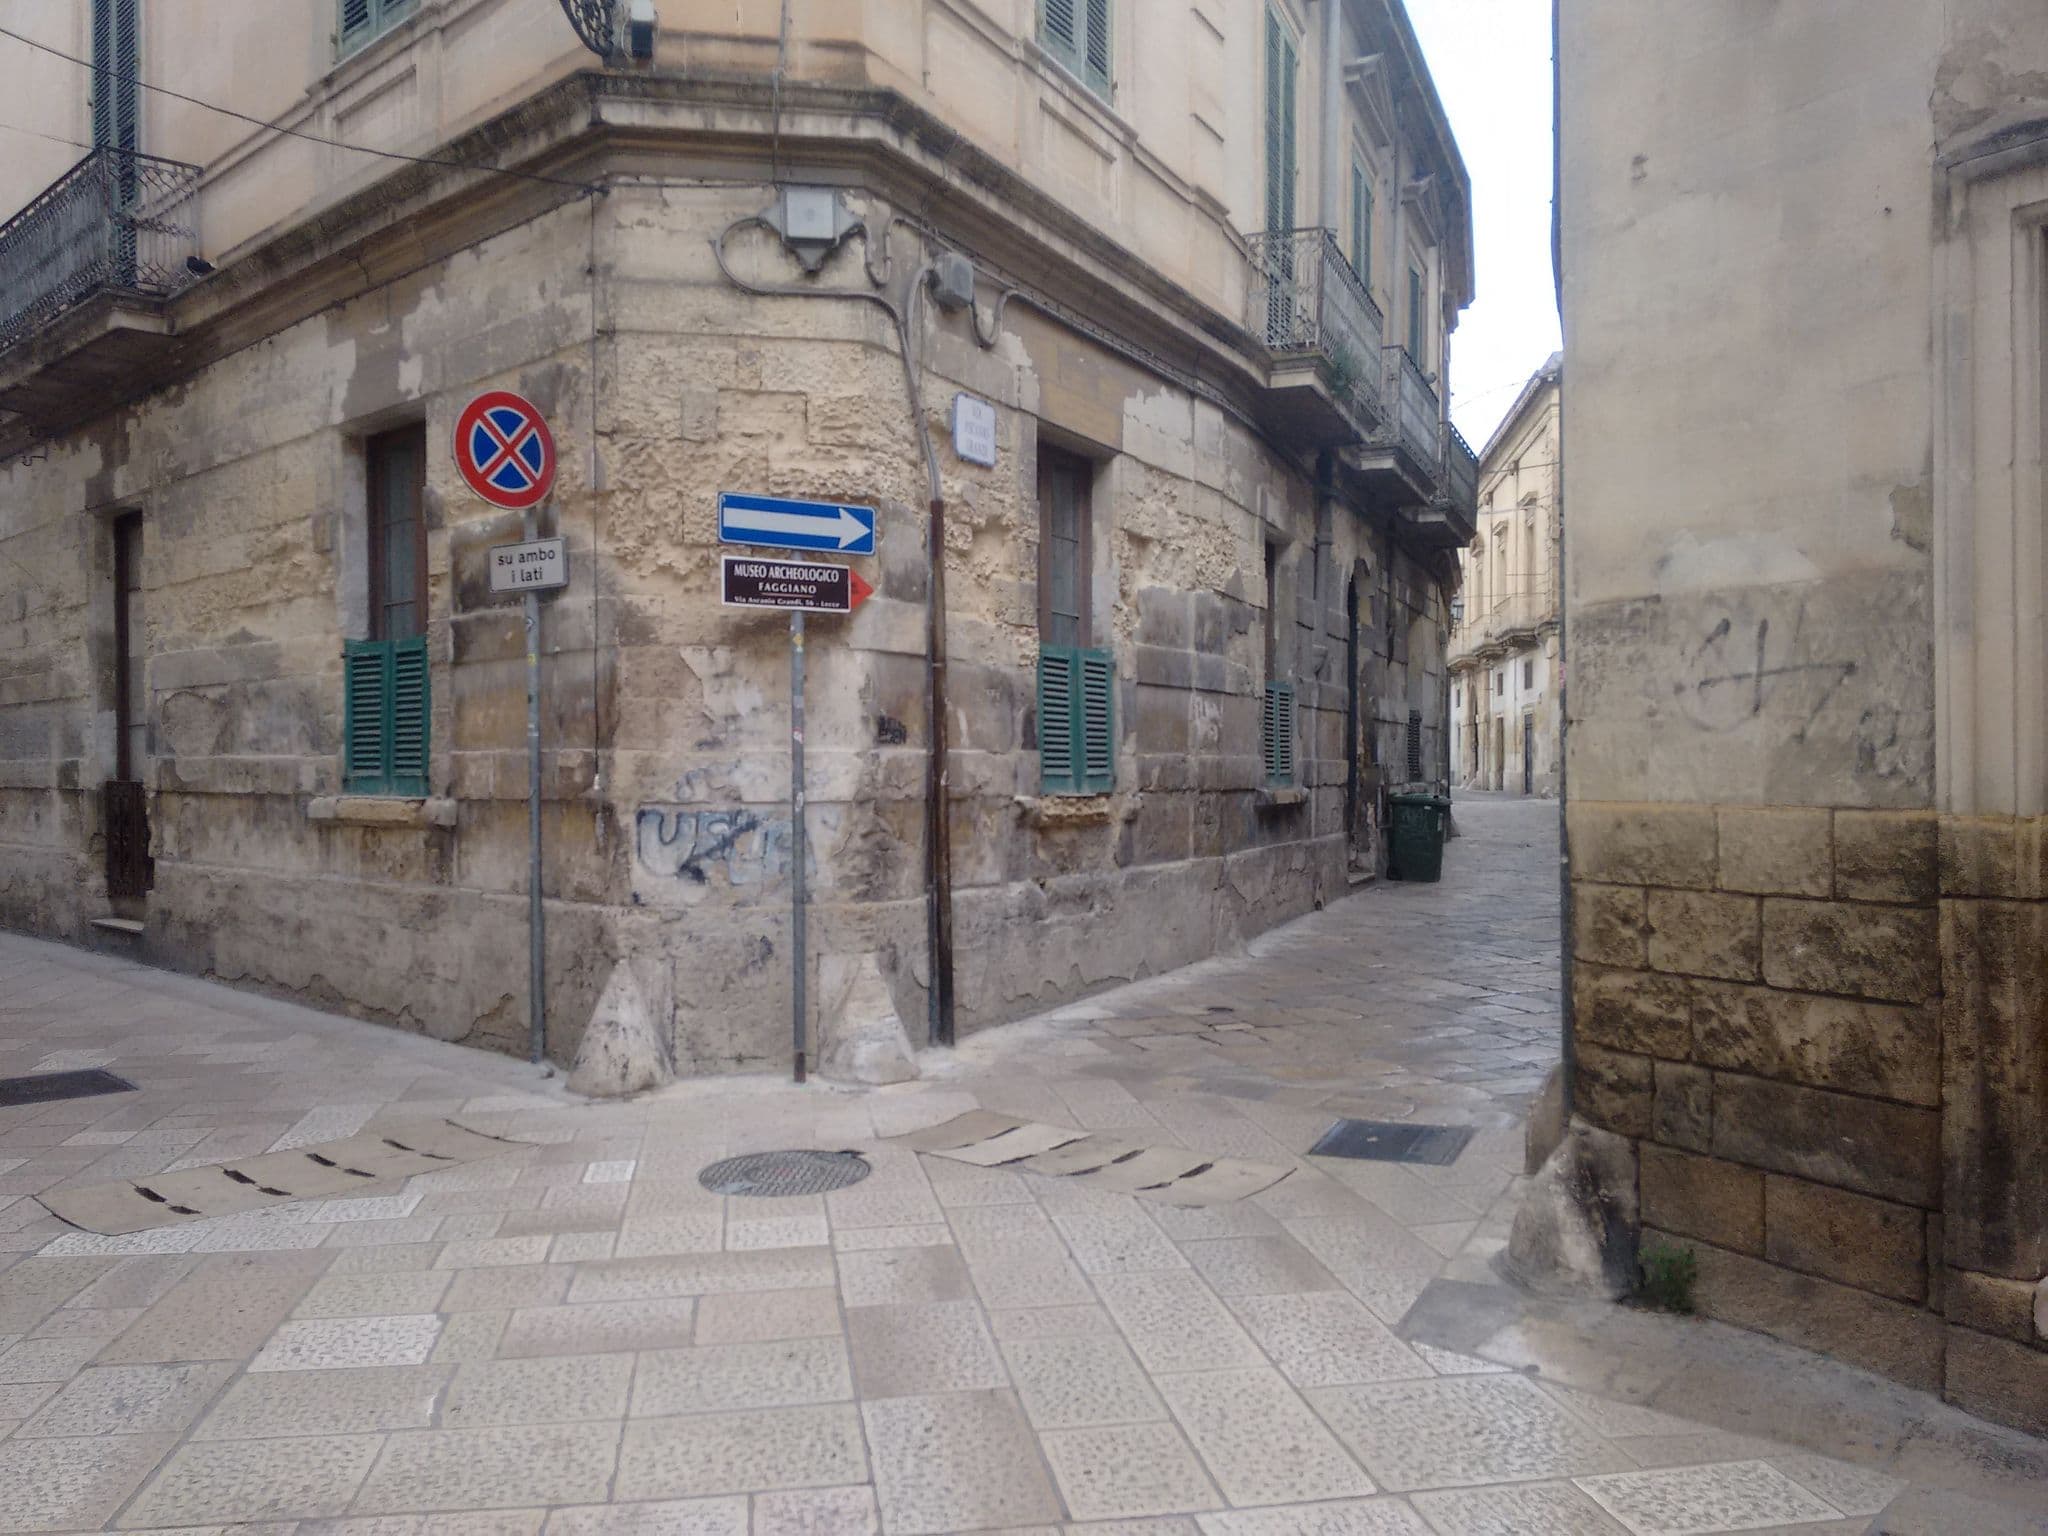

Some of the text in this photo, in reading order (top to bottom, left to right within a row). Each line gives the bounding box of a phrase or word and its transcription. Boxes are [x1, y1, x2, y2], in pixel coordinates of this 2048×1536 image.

[497, 548, 555, 566] su ambo
[520, 567, 544, 582] lati
[734, 564, 839, 582] MUSEO ARCHEOLOGICO
[758, 582, 817, 594] FAGGIANO
[734, 595, 746, 604] Via
